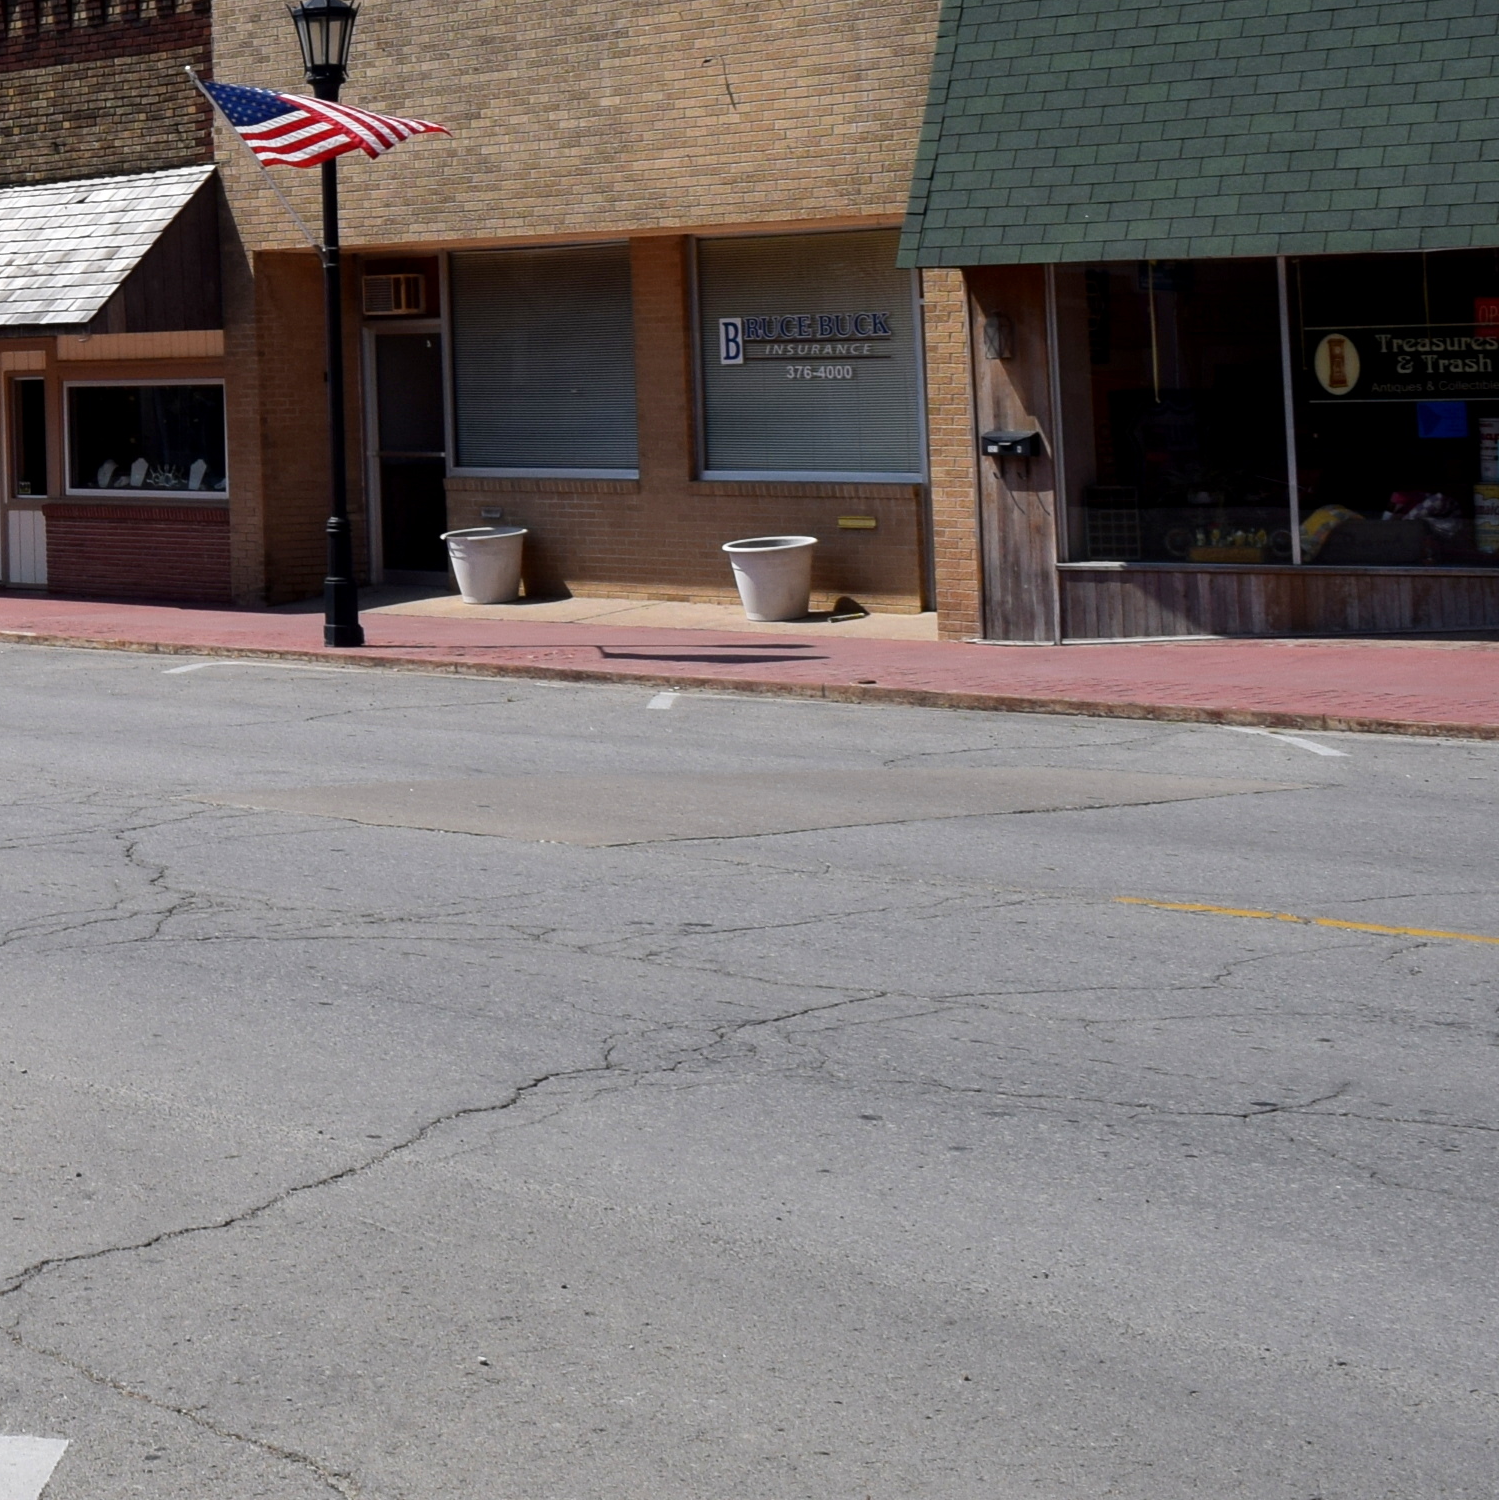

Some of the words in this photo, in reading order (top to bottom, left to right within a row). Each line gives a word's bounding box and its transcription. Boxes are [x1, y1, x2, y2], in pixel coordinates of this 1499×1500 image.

[721, 314, 812, 362] BRUCE
[817, 311, 892, 337] BUCK
[1374, 334, 1499, 354] Treasures
[765, 343, 873, 355] INSURANCE
[1396, 355, 1414, 374] &
[1421, 353, 1493, 374] Trash
[786, 365, 853, 380] 376-4000
[1370, 382, 1423, 394] Antiques
[1425, 380, 1435, 391] &
